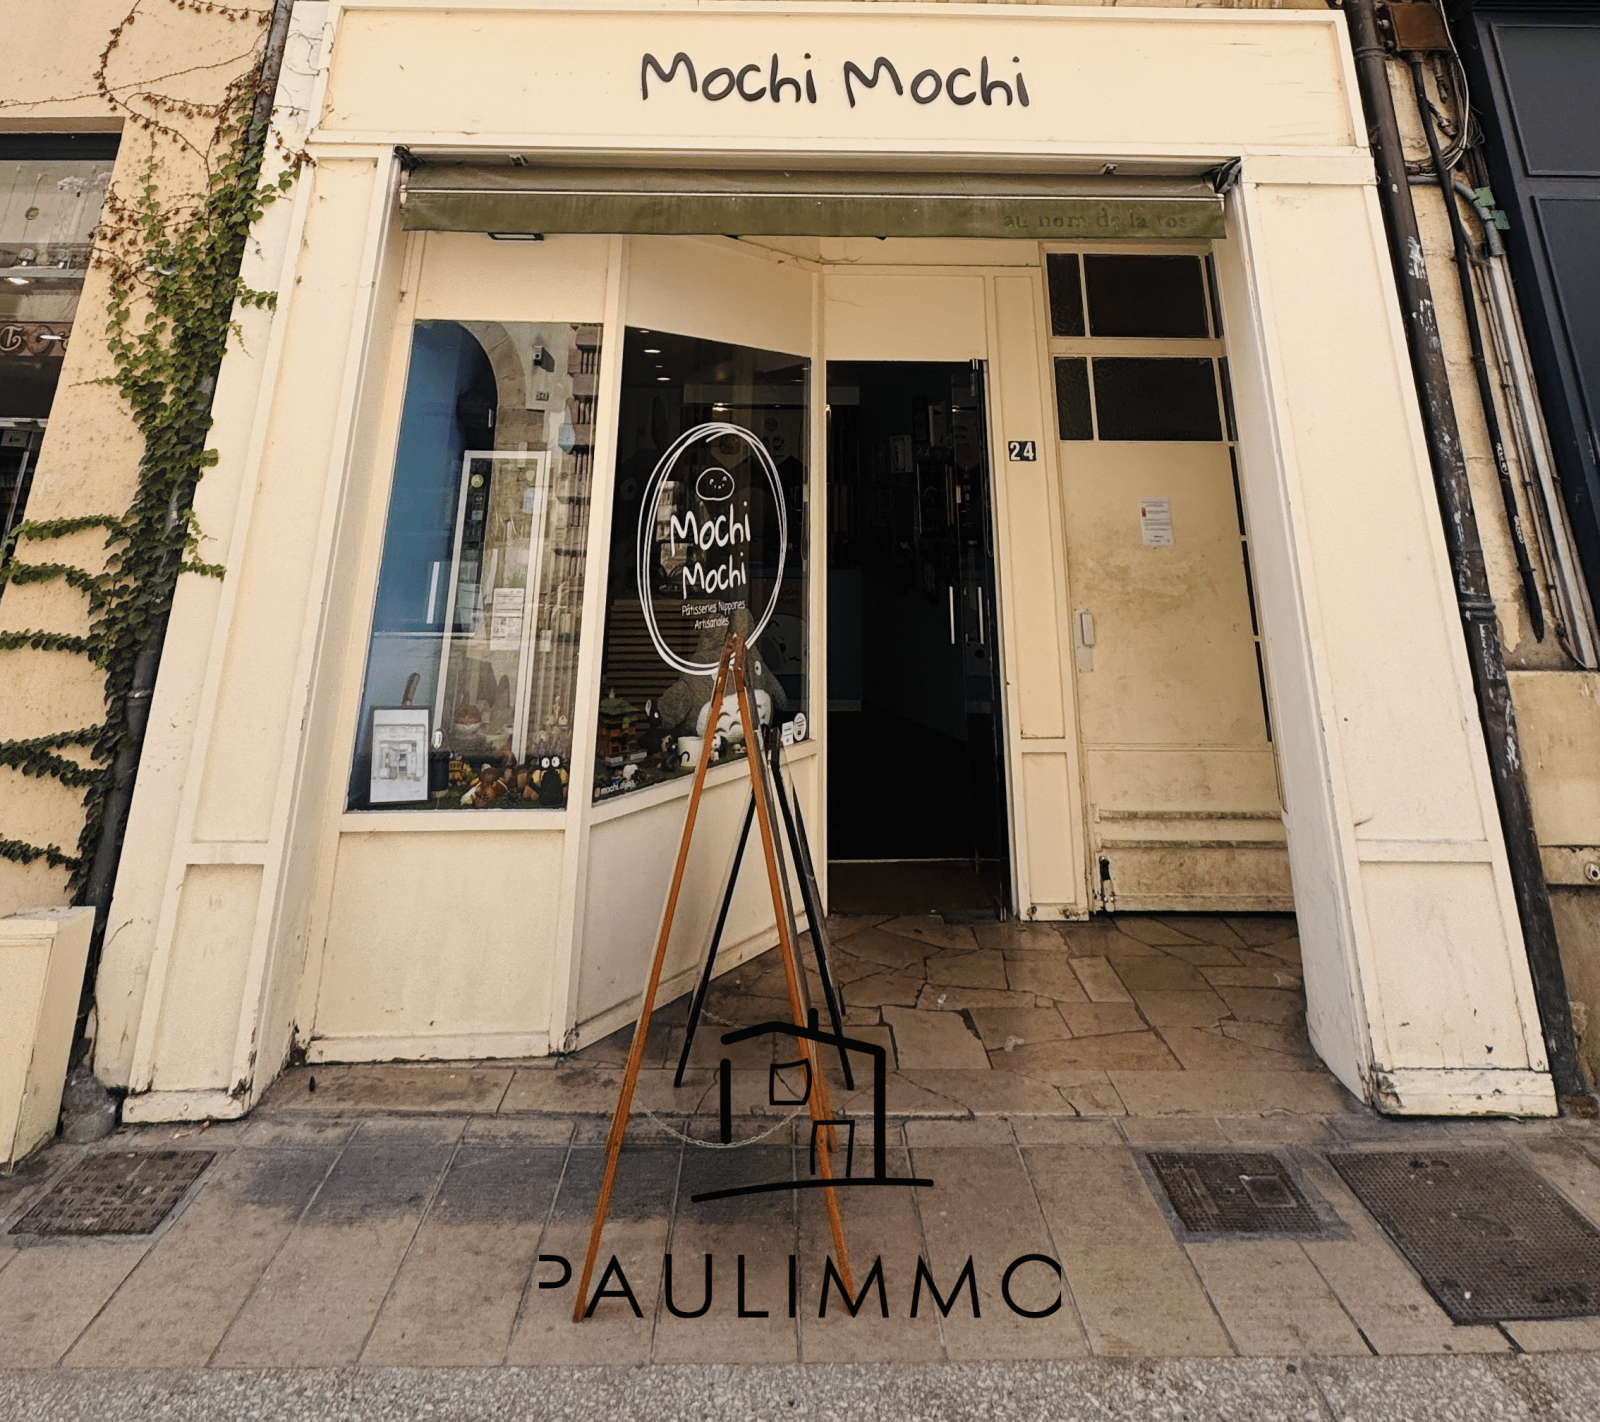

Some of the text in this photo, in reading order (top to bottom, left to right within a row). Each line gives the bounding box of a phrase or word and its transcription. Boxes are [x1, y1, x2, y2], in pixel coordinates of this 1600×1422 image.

[641, 51, 1030, 108] Mochi Mochi
[1003, 214, 1028, 228] au
[1038, 213, 1088, 228] nom
[1009, 441, 1035, 461] 24
[670, 501, 751, 557] Mochi
[682, 552, 747, 600] Mochi
